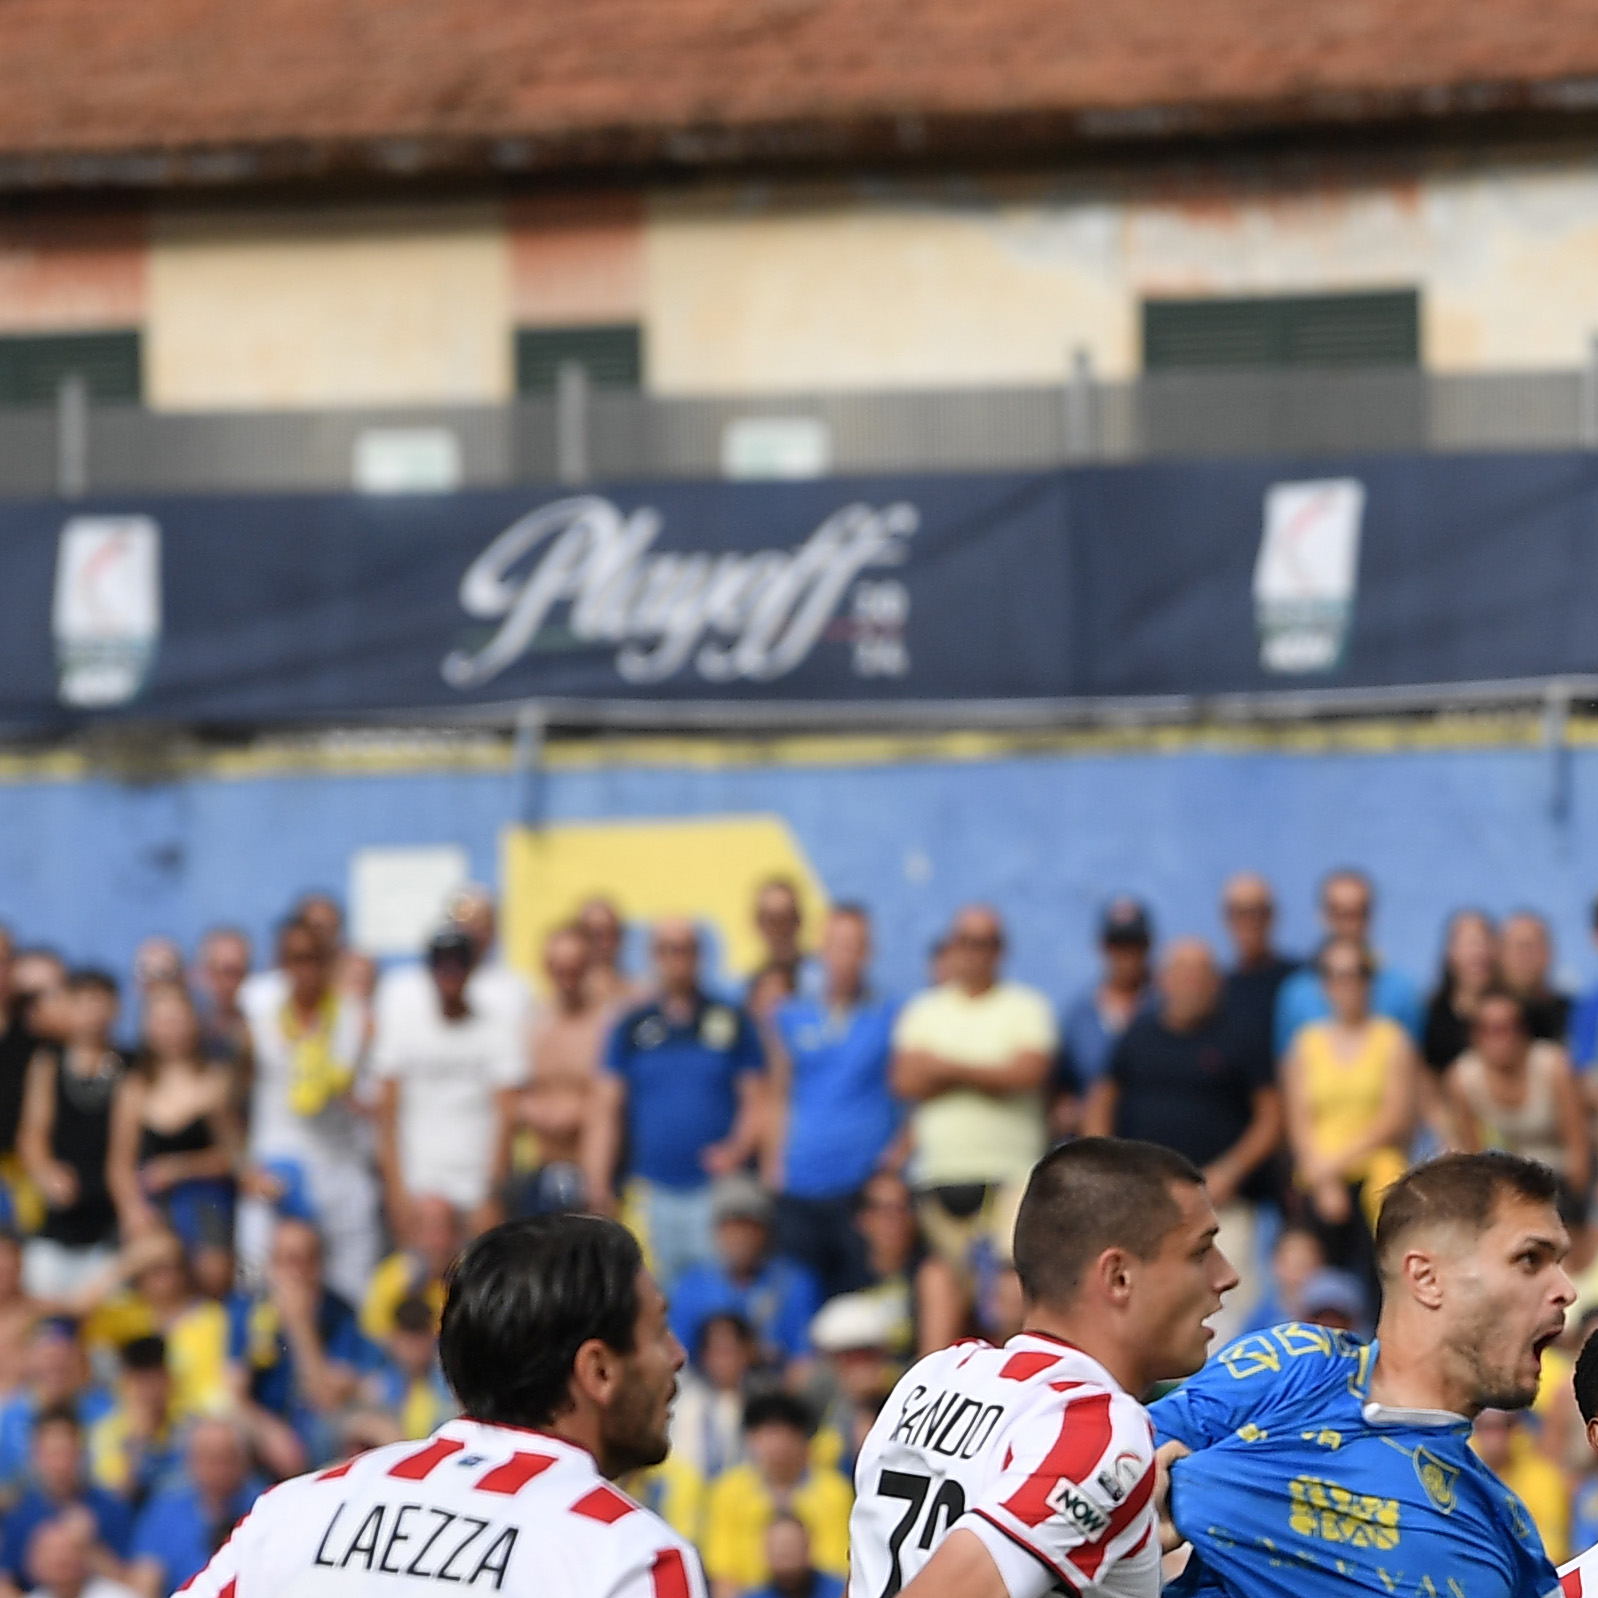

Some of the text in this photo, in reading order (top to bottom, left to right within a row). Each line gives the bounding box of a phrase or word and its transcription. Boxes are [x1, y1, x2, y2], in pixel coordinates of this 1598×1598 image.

[442, 494, 919, 688] Playoff
[314, 1502, 520, 1589] LAEZZA
[1055, 1488, 1107, 1533] NOW
